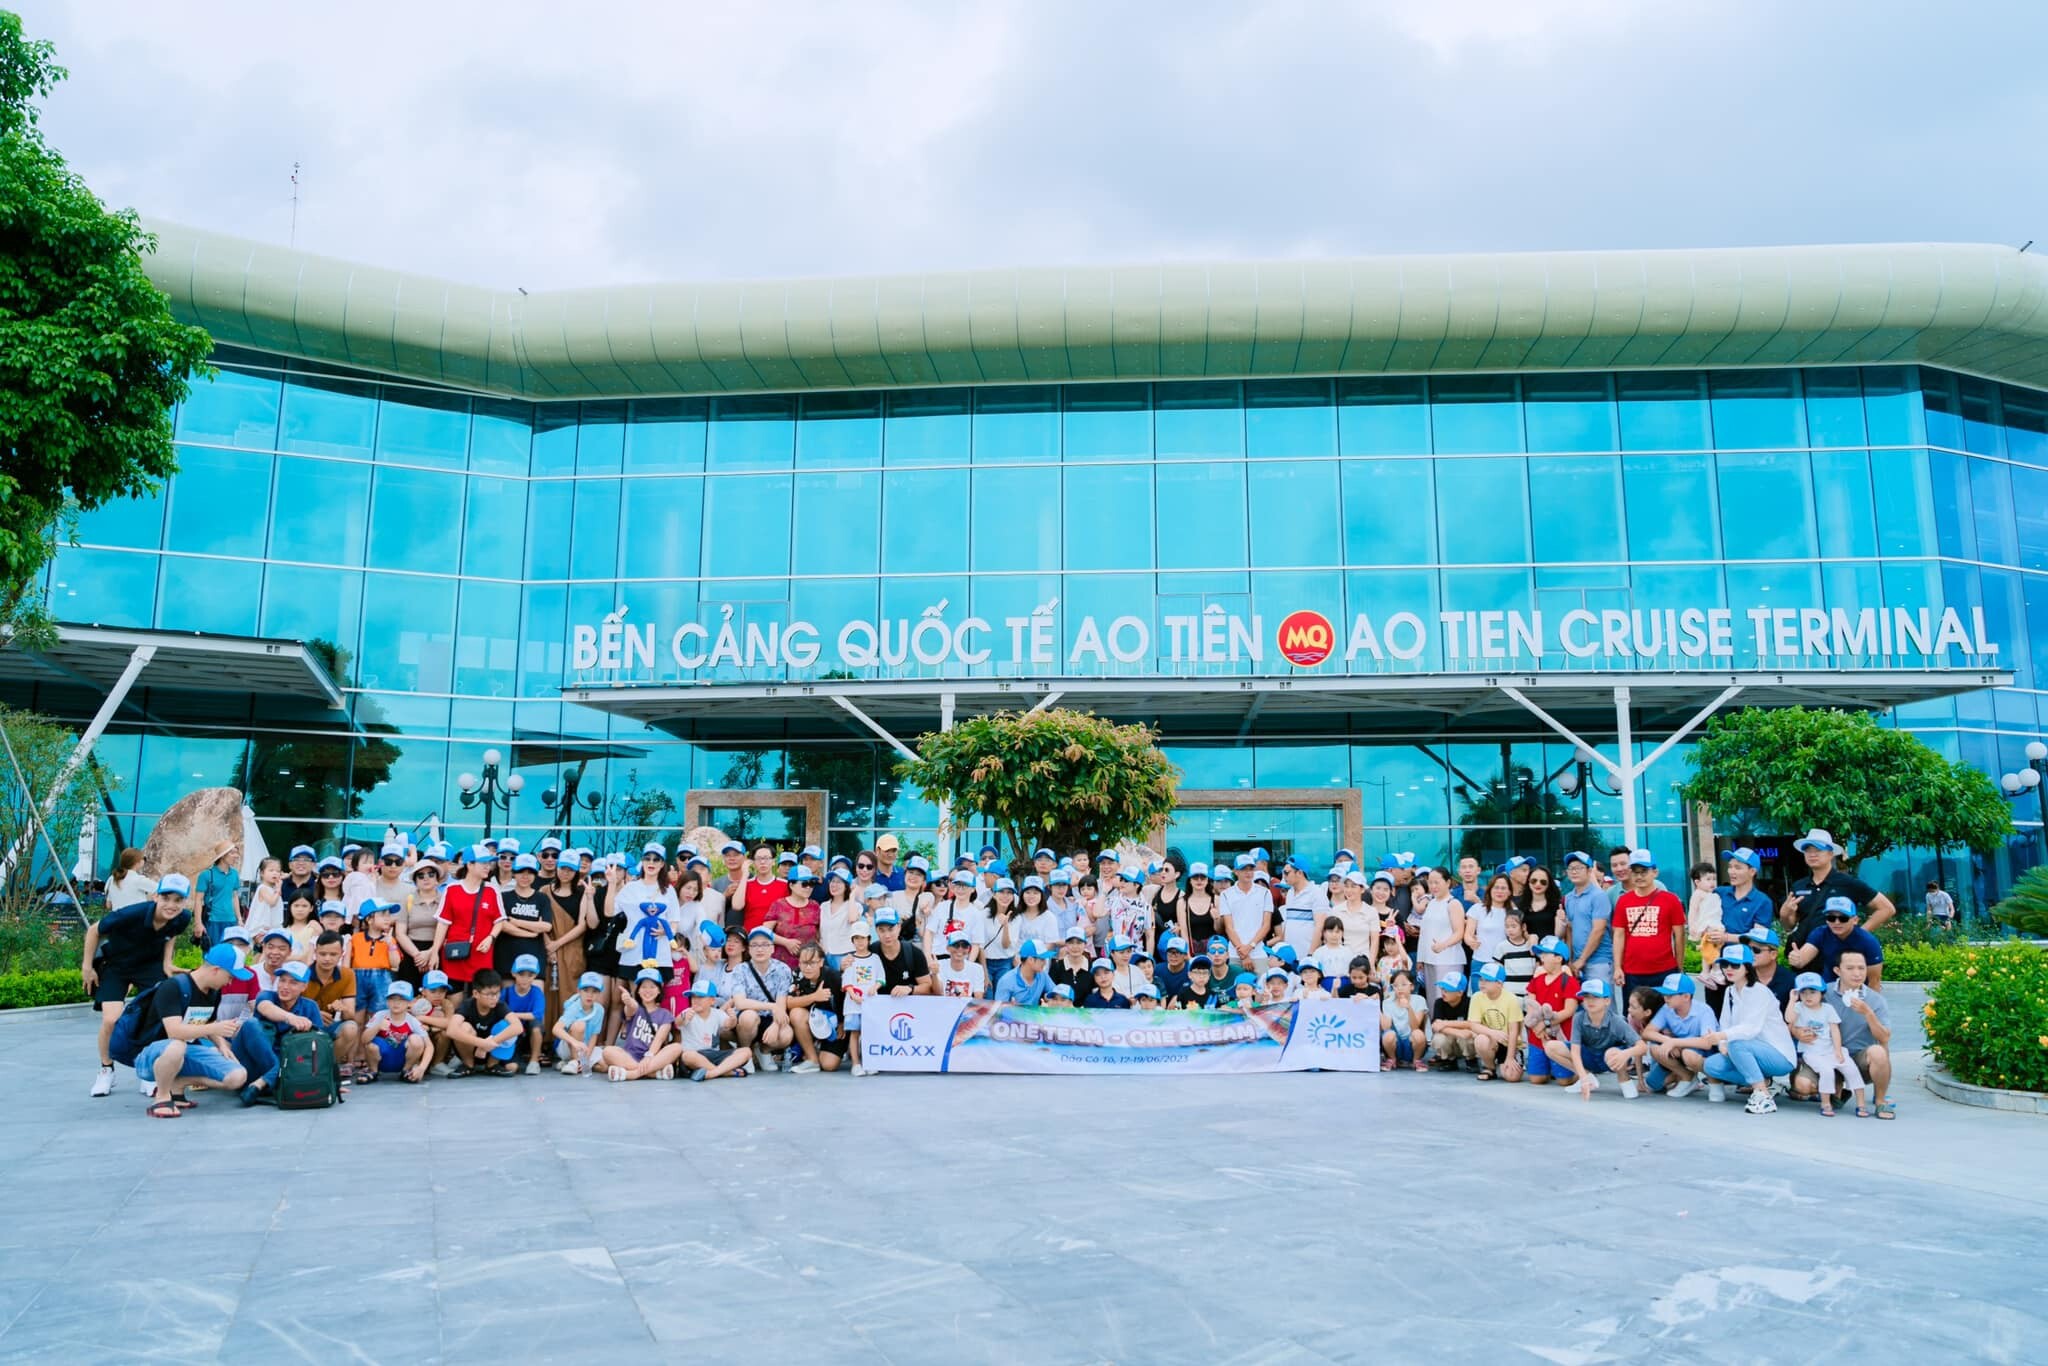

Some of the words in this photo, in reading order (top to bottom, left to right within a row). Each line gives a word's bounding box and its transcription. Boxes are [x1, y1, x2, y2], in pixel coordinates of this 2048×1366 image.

[573, 604, 655, 670] BẾN
[672, 603, 821, 669] CẢNG
[838, 597, 992, 668] QUỐC
[1005, 597, 1060, 664] TẾ
[1069, 615, 1149, 662] AO
[1164, 603, 1263, 662] TIÊN
[1285, 624, 1328, 650] MQ
[1345, 611, 1427, 660] AO
[1440, 609, 1544, 659] TIEN
[1559, 608, 1734, 658] CRUISE
[1746, 606, 1999, 657] TERMINAL
[992, 1020, 1041, 1041] ONE
[1043, 1024, 1104, 1045] TEAM
[1127, 1029, 1176, 1046] ONE
[1178, 1022, 1256, 1044] DREAM
[1324, 1032, 1366, 1049] PNS
[869, 1044, 936, 1057] CMAXX
